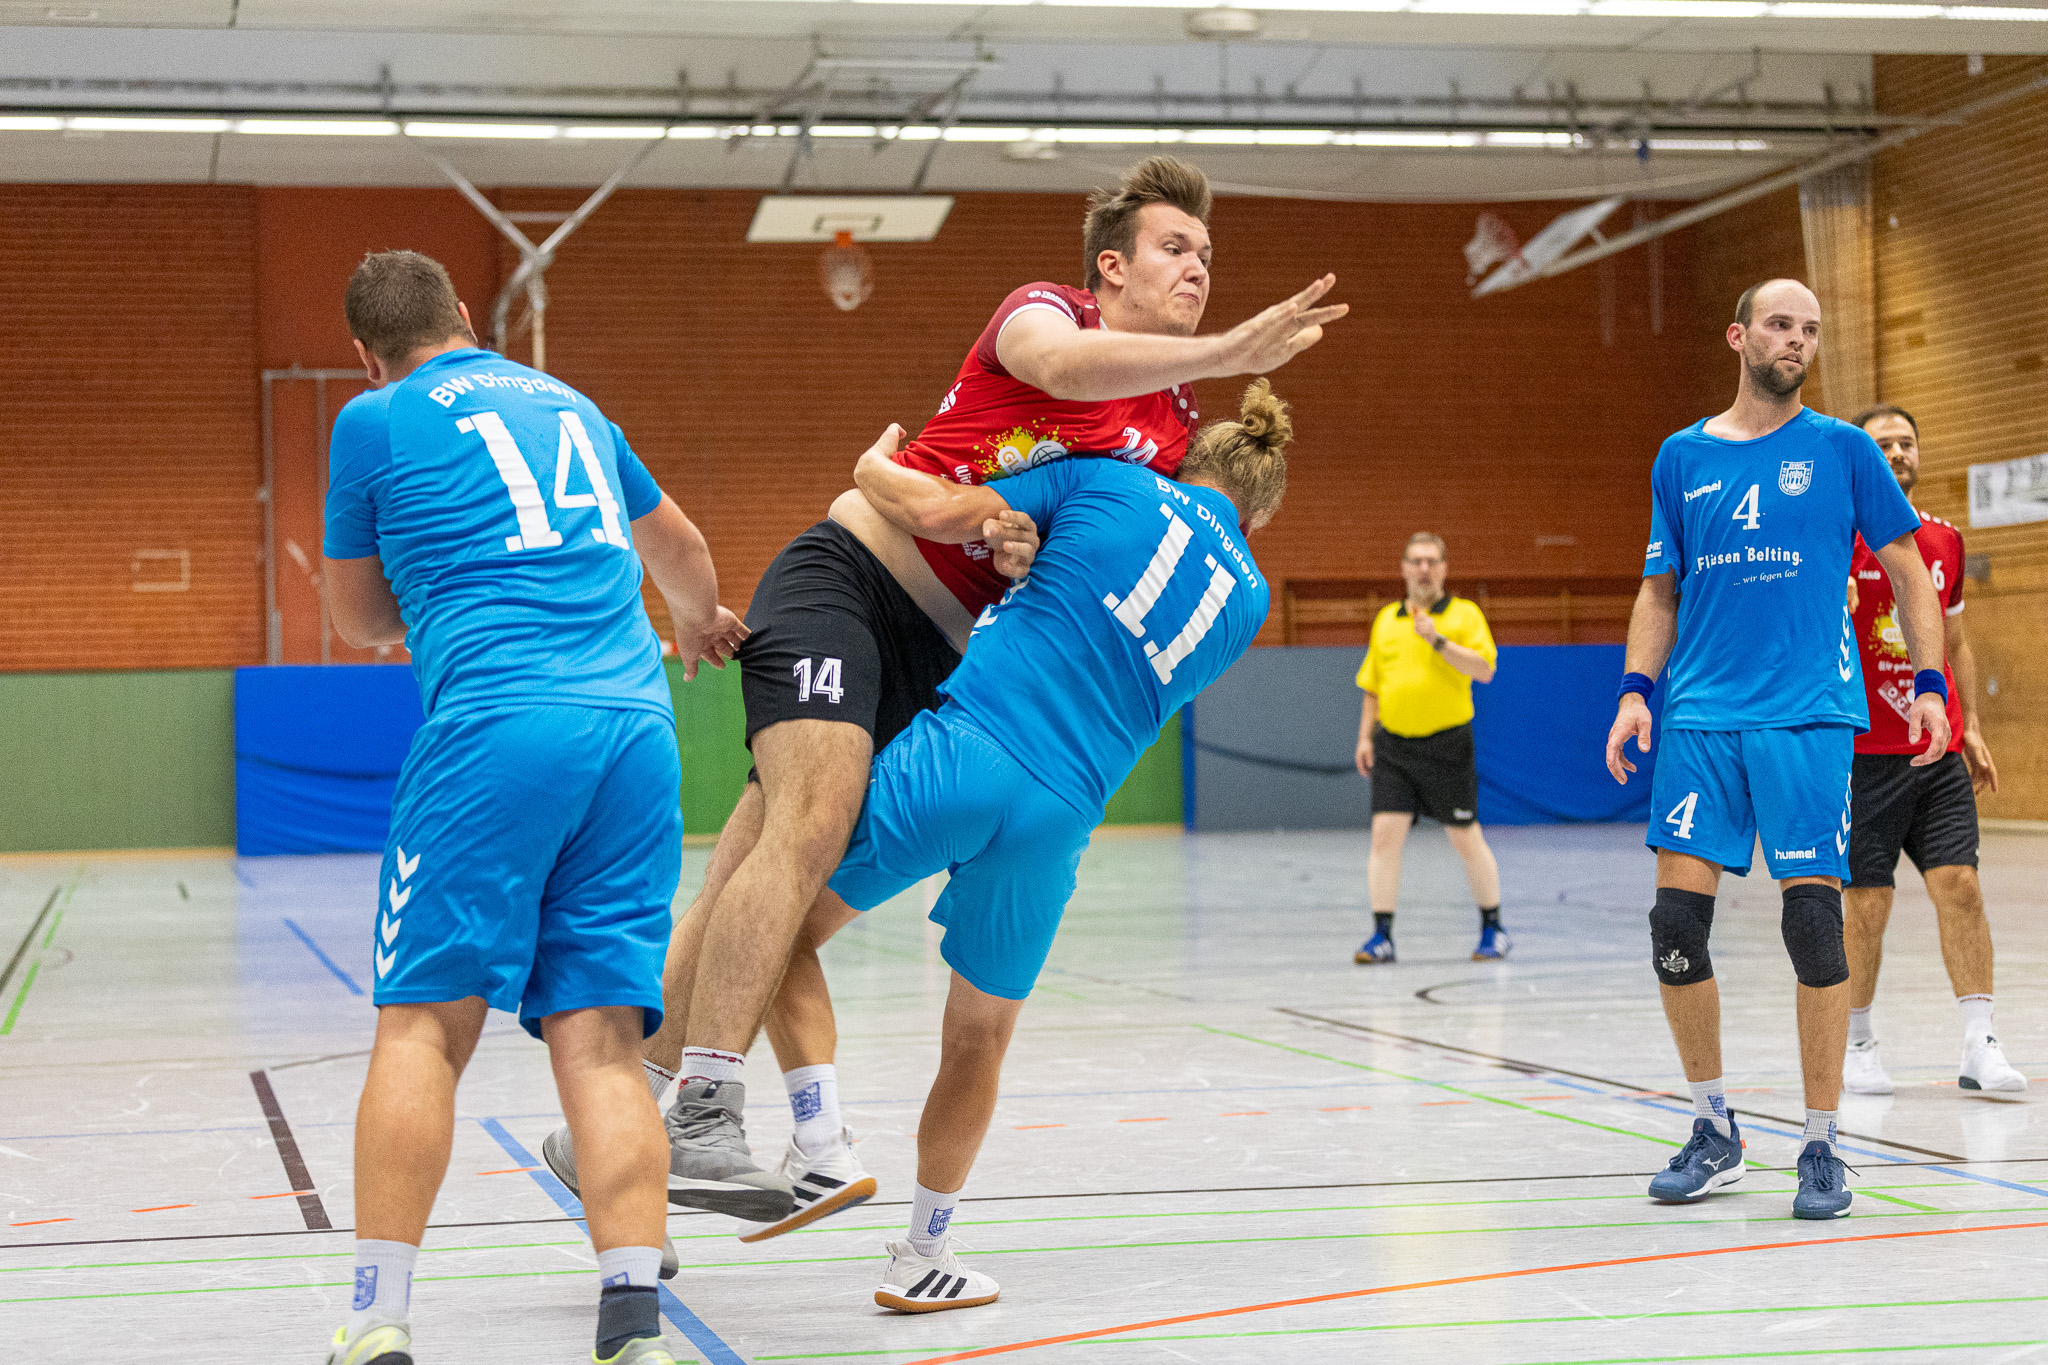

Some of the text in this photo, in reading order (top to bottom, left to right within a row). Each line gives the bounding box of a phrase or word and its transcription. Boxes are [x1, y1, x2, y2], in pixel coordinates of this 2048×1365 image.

[428, 373, 578, 408] BW Dingden
[455, 411, 630, 552] 14
[1684, 480, 1721, 502] hummel
[1732, 484, 1761, 530] 4
[1155, 477, 1258, 589] BW Dingden
[1102, 502, 1237, 685] 11
[1743, 575, 1758, 584] wir
[1759, 572, 1782, 583] legen
[1784, 570, 1798, 578] los!
[793, 657, 844, 704] 14
[1665, 791, 1699, 839] 4
[1775, 847, 1816, 860] hummel
